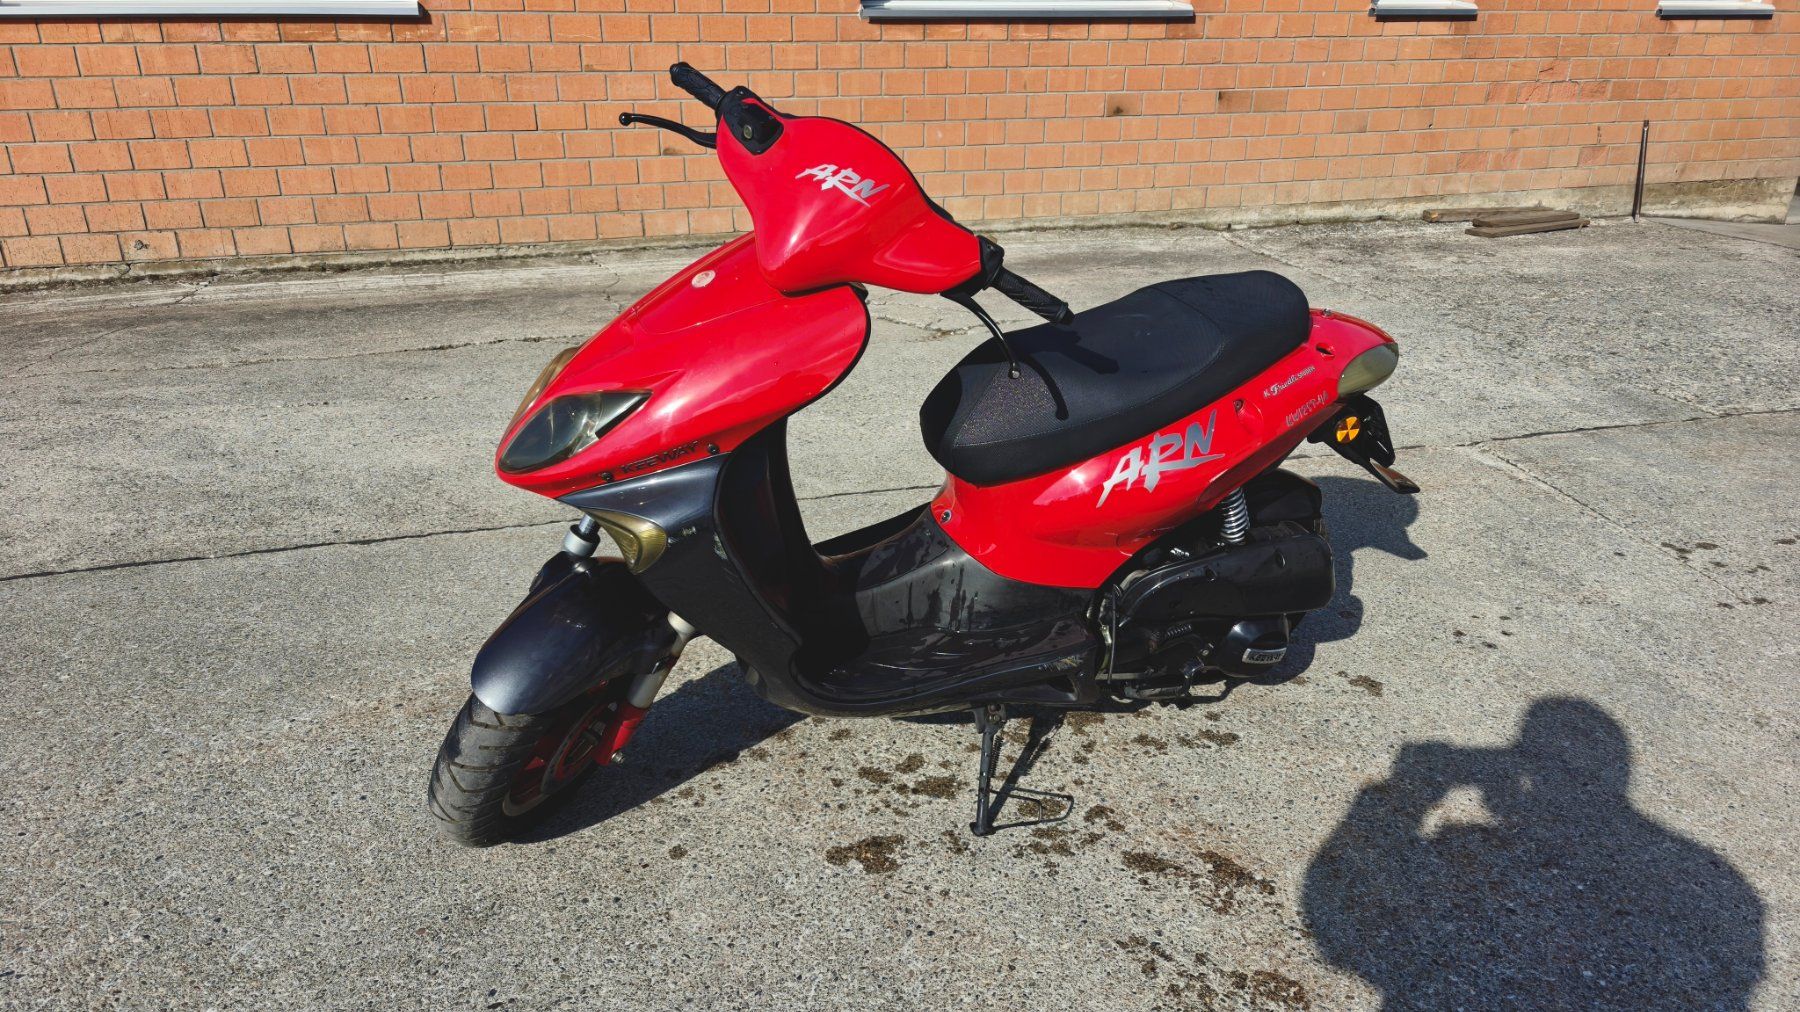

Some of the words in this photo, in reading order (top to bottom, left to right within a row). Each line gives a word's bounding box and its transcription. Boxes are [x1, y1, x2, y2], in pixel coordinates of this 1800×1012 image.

[795, 163, 891, 208] ARN
[620, 441, 699, 474] KEEWAY
[1096, 408, 1226, 509] ARN
